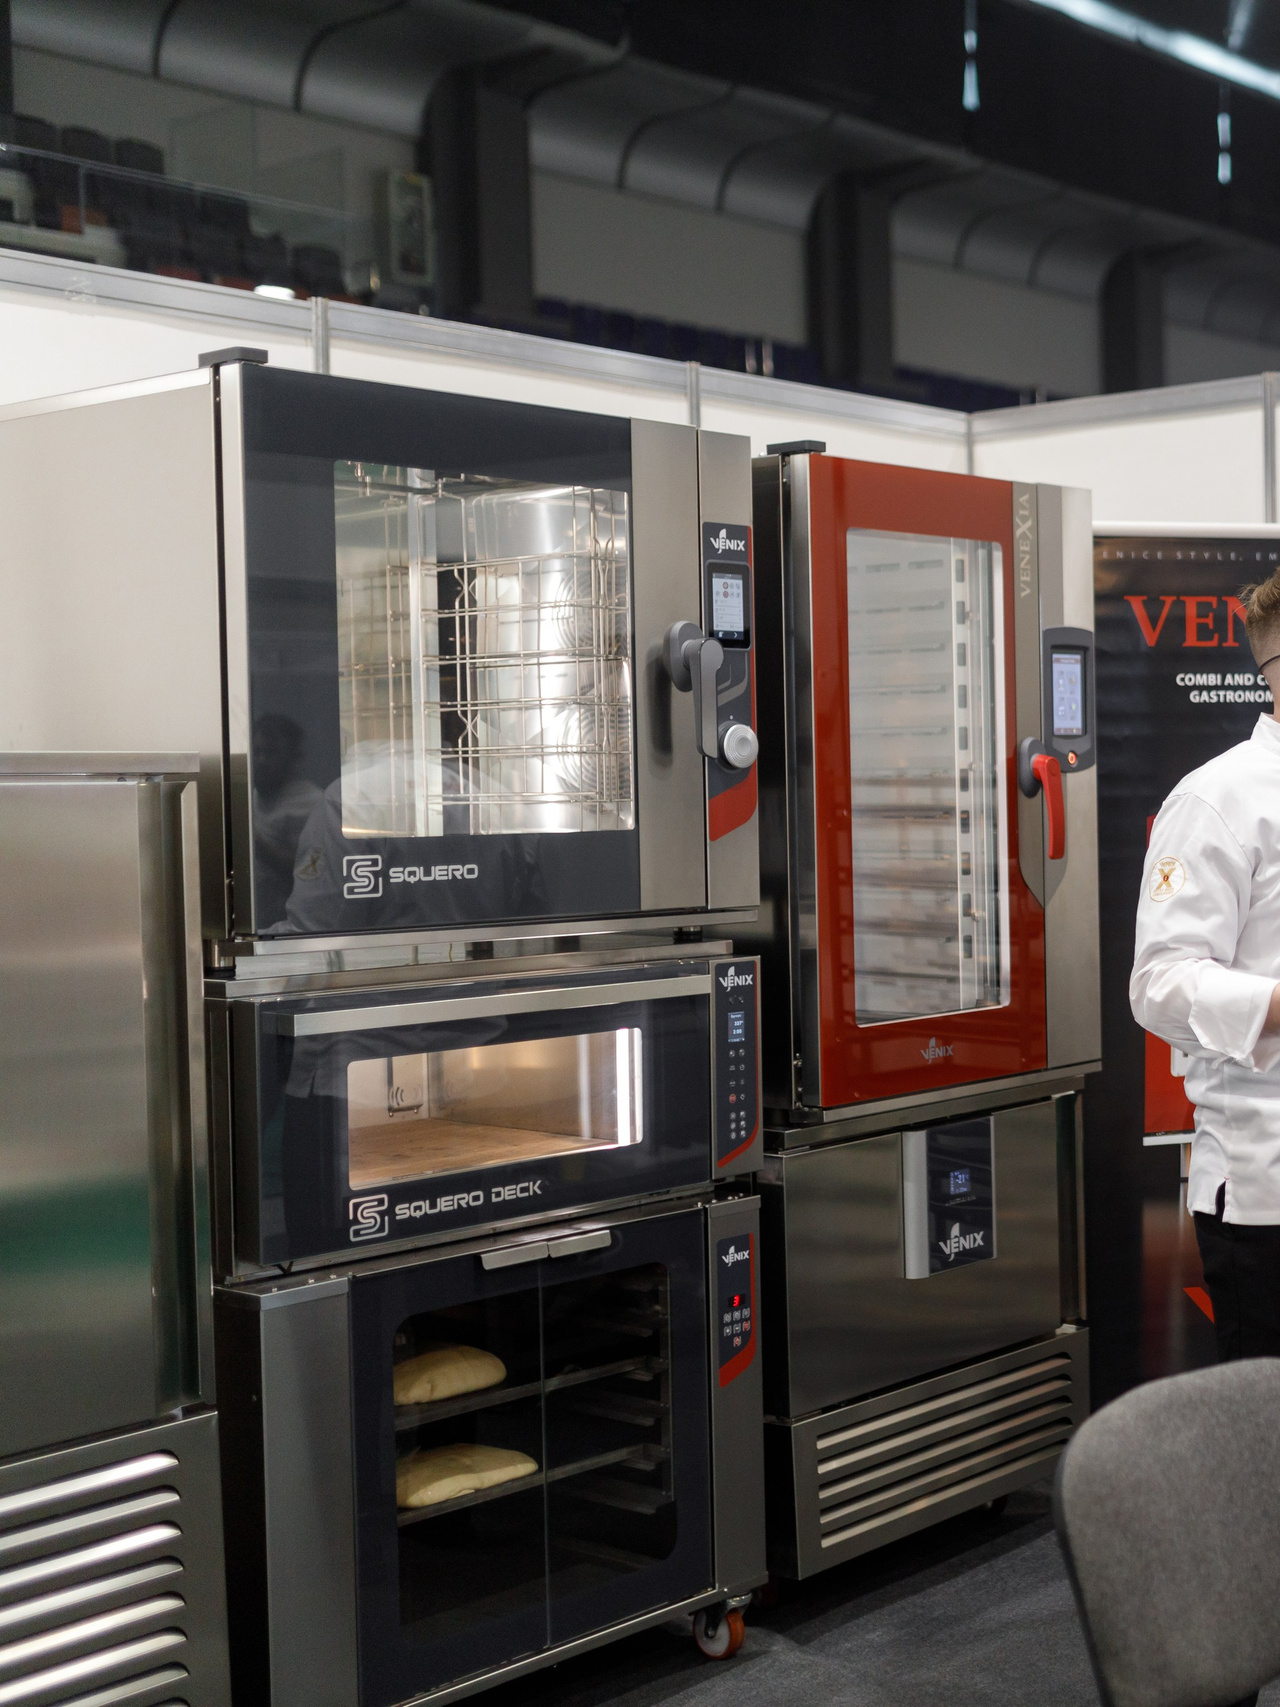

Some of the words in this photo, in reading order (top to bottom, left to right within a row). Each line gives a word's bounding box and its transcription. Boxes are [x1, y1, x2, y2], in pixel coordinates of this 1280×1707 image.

[710, 528, 745, 554] VENIX
[1016, 493, 1032, 598] VENEXIA
[1103, 551, 1163, 560] ENICE
[1176, 673, 1222, 687] COMBI
[1224, 673, 1255, 686] AND
[1189, 690, 1275, 703] GASTRONOM
[389, 864, 478, 884] SQUERO
[719, 966, 753, 992] VENIX
[920, 1037, 954, 1064] VENIX
[395, 1191, 484, 1220] SQUERO
[491, 1180, 542, 1203] DECK
[939, 1222, 984, 1262] VENIX
[721, 1245, 750, 1267] VENIX
